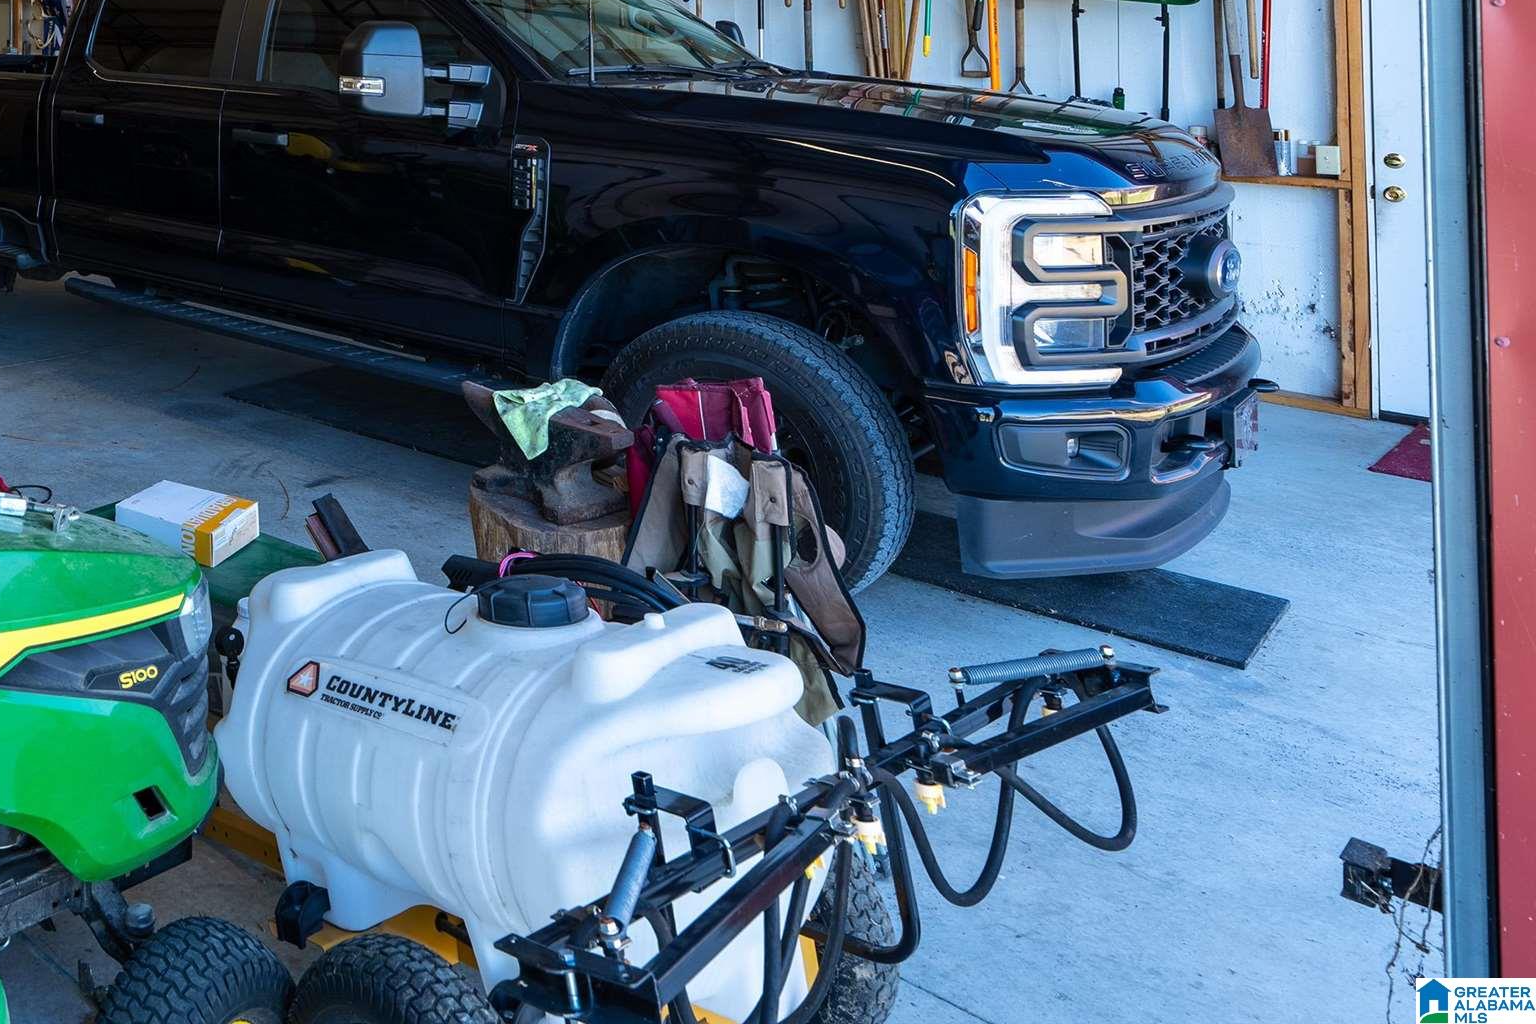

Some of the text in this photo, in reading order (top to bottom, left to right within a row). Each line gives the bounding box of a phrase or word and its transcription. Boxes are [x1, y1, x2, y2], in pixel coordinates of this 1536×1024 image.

[119, 665, 159, 689] S100
[320, 692, 350, 710] TRACTOR
[349, 702, 374, 717] SUPPLY
